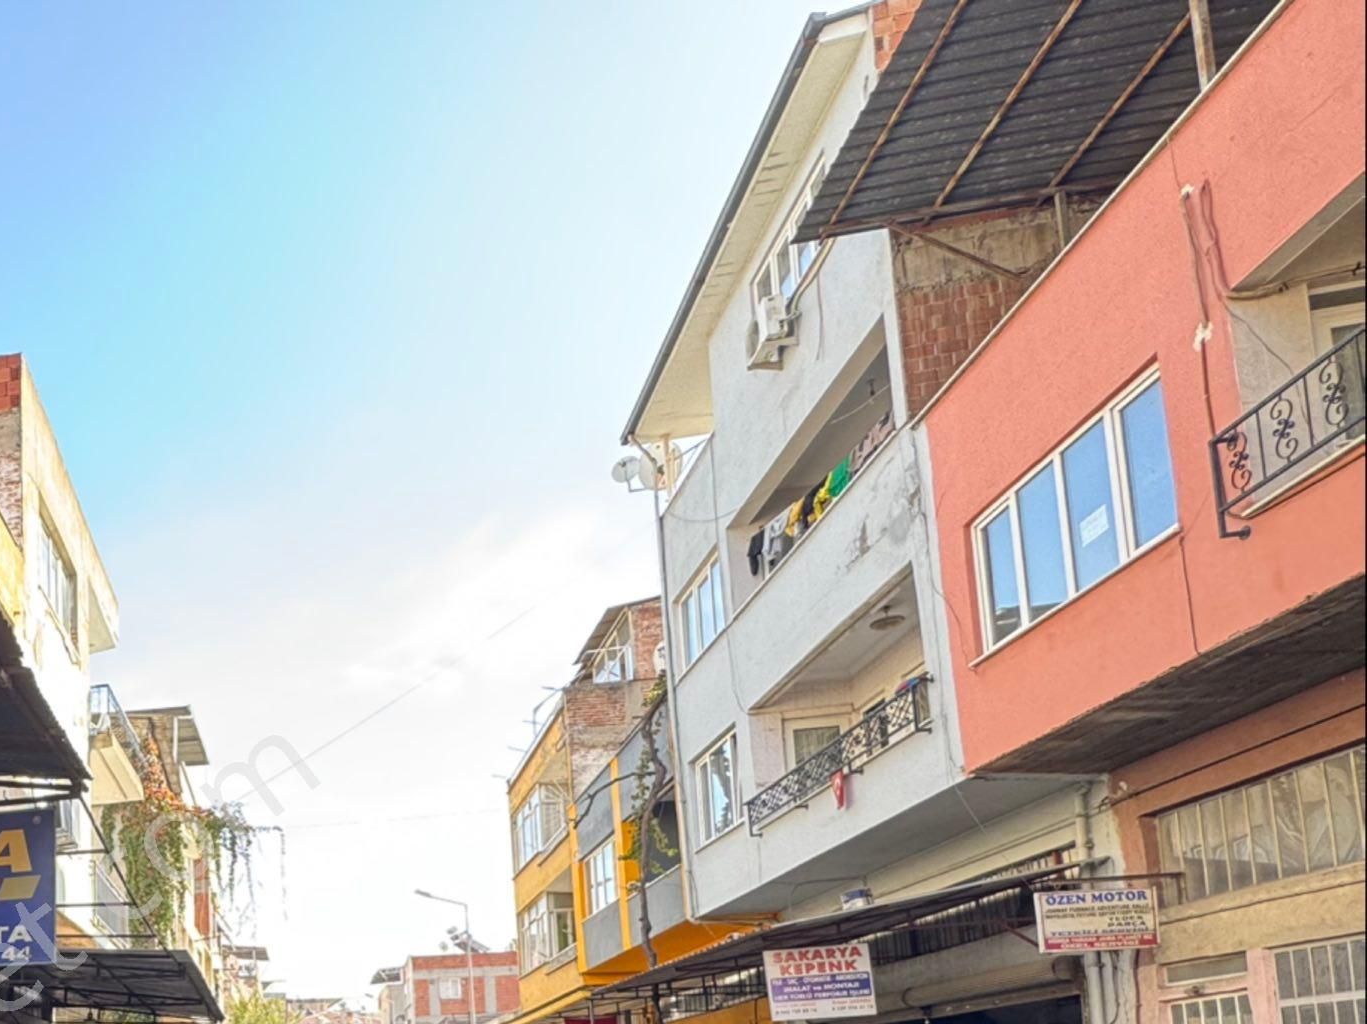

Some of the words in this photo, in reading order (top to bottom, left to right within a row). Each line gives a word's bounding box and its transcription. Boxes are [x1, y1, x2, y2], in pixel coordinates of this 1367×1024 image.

[1046, 894, 1086, 906] ÖZEN
[1091, 890, 1148, 903] MOTOR
[772, 946, 862, 963] SAKARYA
[780, 960, 857, 976] KEPENK
